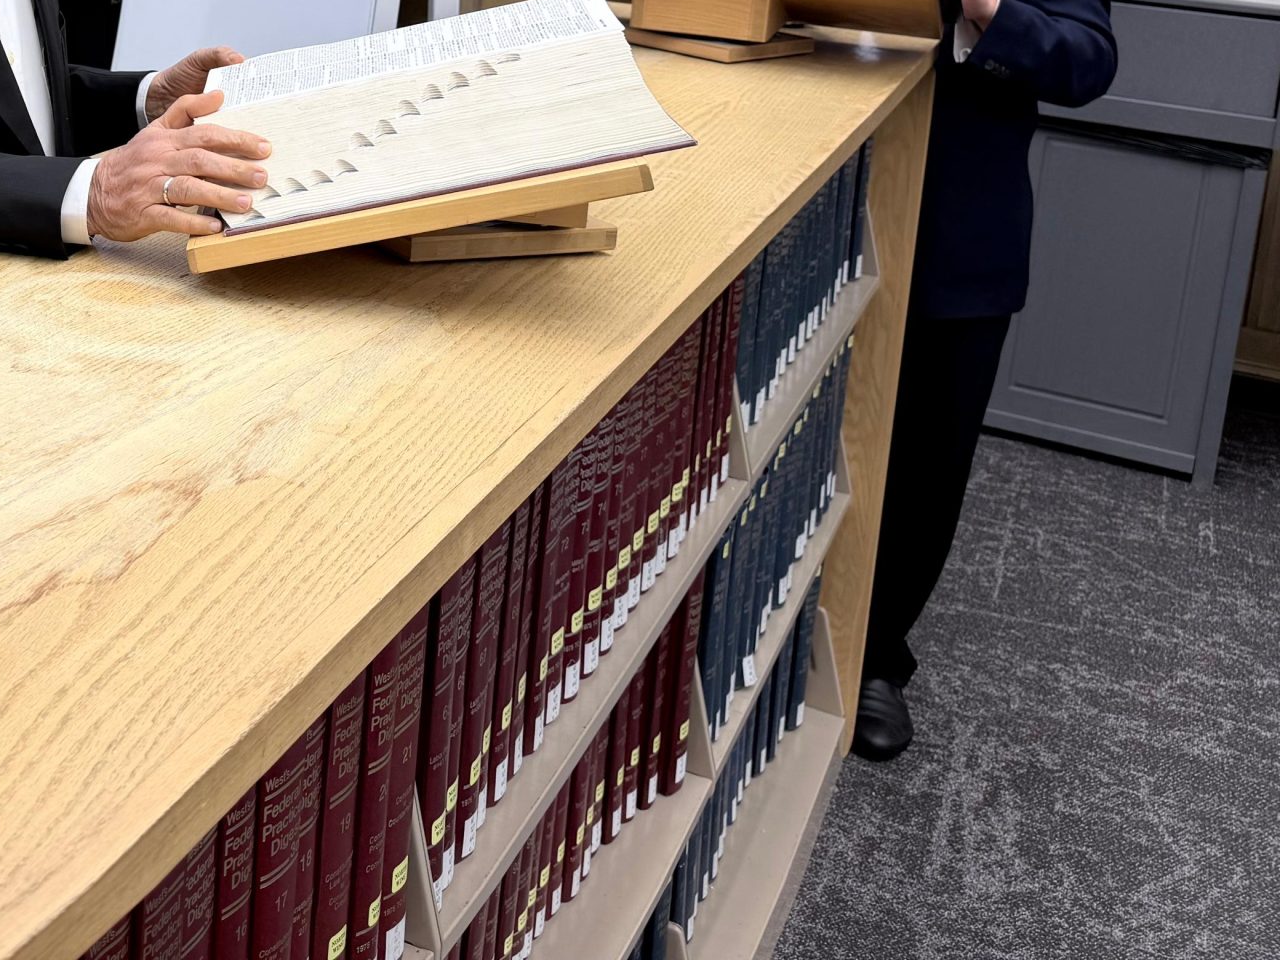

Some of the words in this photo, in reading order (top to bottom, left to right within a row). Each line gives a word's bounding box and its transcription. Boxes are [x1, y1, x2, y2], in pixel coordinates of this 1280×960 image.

[399, 642, 424, 675] Federal
[402, 741, 412, 764] 21
[265, 768, 292, 793] West's
[226, 799, 254, 827] West's
[263, 783, 301, 823] Federal
[340, 811, 352, 835] 19
[300, 848, 312, 872] 18
[145, 886, 170, 914] West's
[276, 889, 288, 913] 17
[144, 893, 181, 944] Federal
[235, 919, 248, 942] 16
